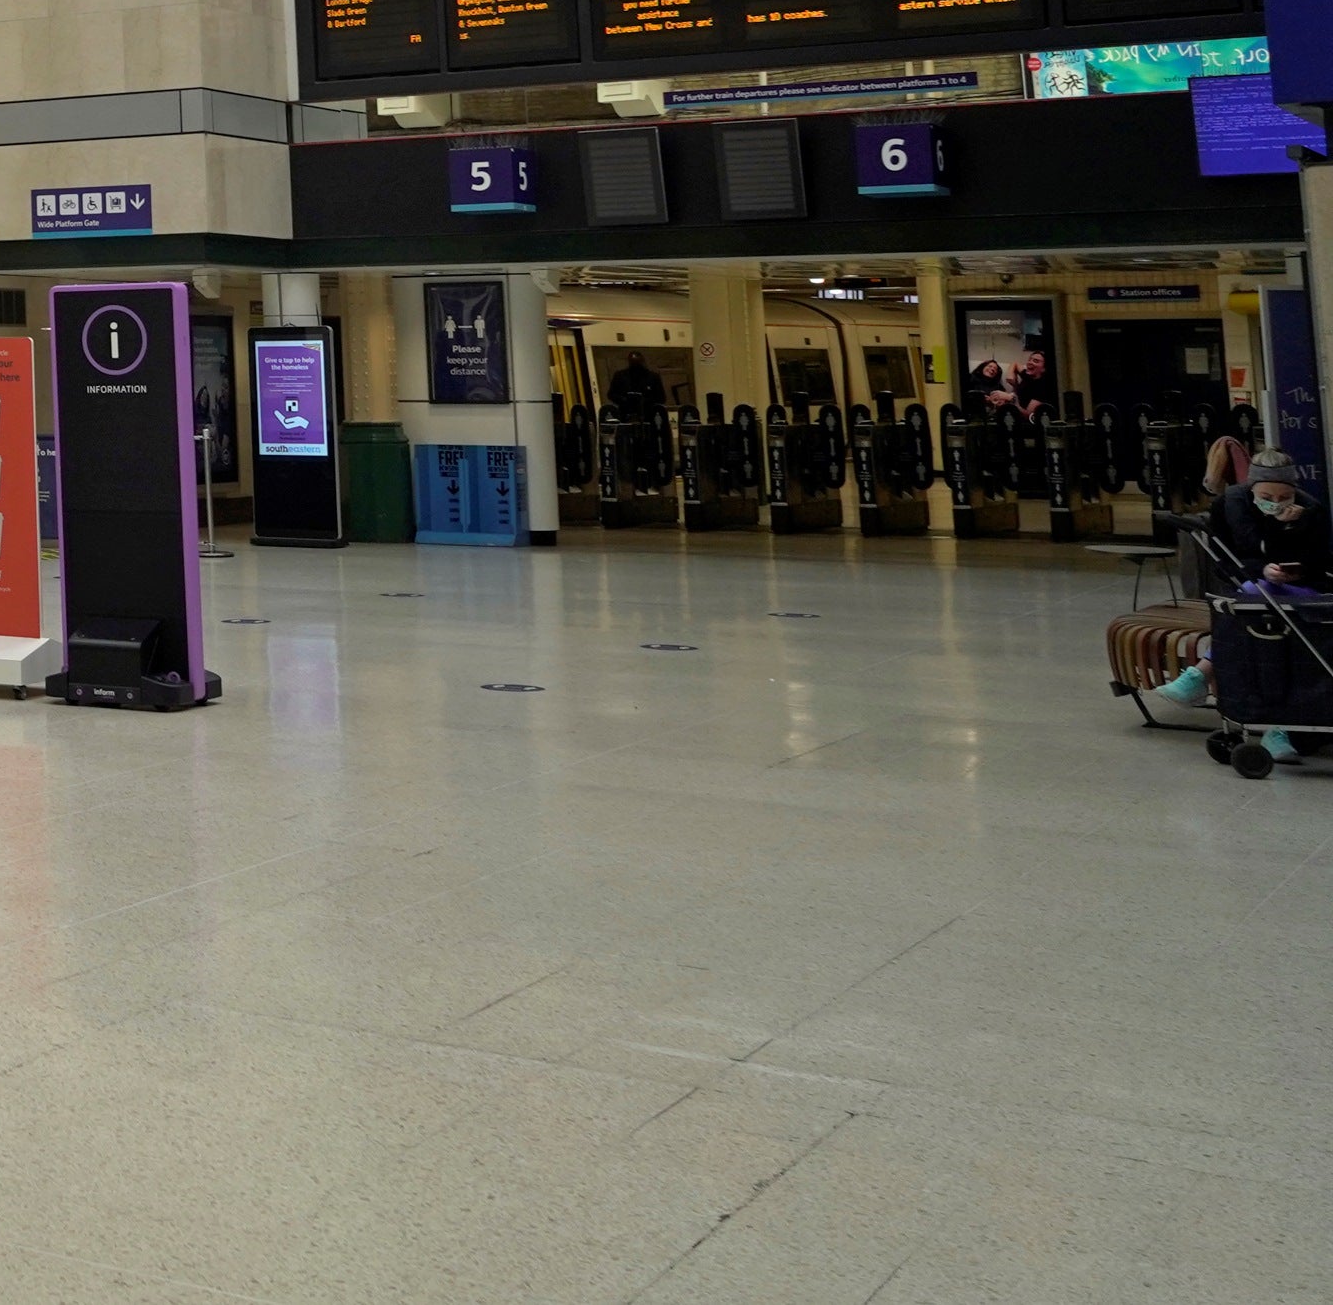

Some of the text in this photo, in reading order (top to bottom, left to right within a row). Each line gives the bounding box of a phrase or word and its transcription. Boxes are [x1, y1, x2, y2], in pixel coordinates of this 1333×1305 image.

[735, 90, 777, 99] departures
[779, 88, 805, 96] please
[822, 84, 859, 92] indicator
[860, 82, 896, 90] between
[898, 79, 939, 89] platforms
[881, 138, 908, 171] 6
[471, 161, 491, 191] 5
[518, 162, 527, 191] 5
[84, 219, 100, 227] Gate
[453, 345, 481, 353] Please
[447, 356, 488, 366] keep your
[450, 367, 486, 375] distance
[86, 385, 147, 393] INFORMATION
